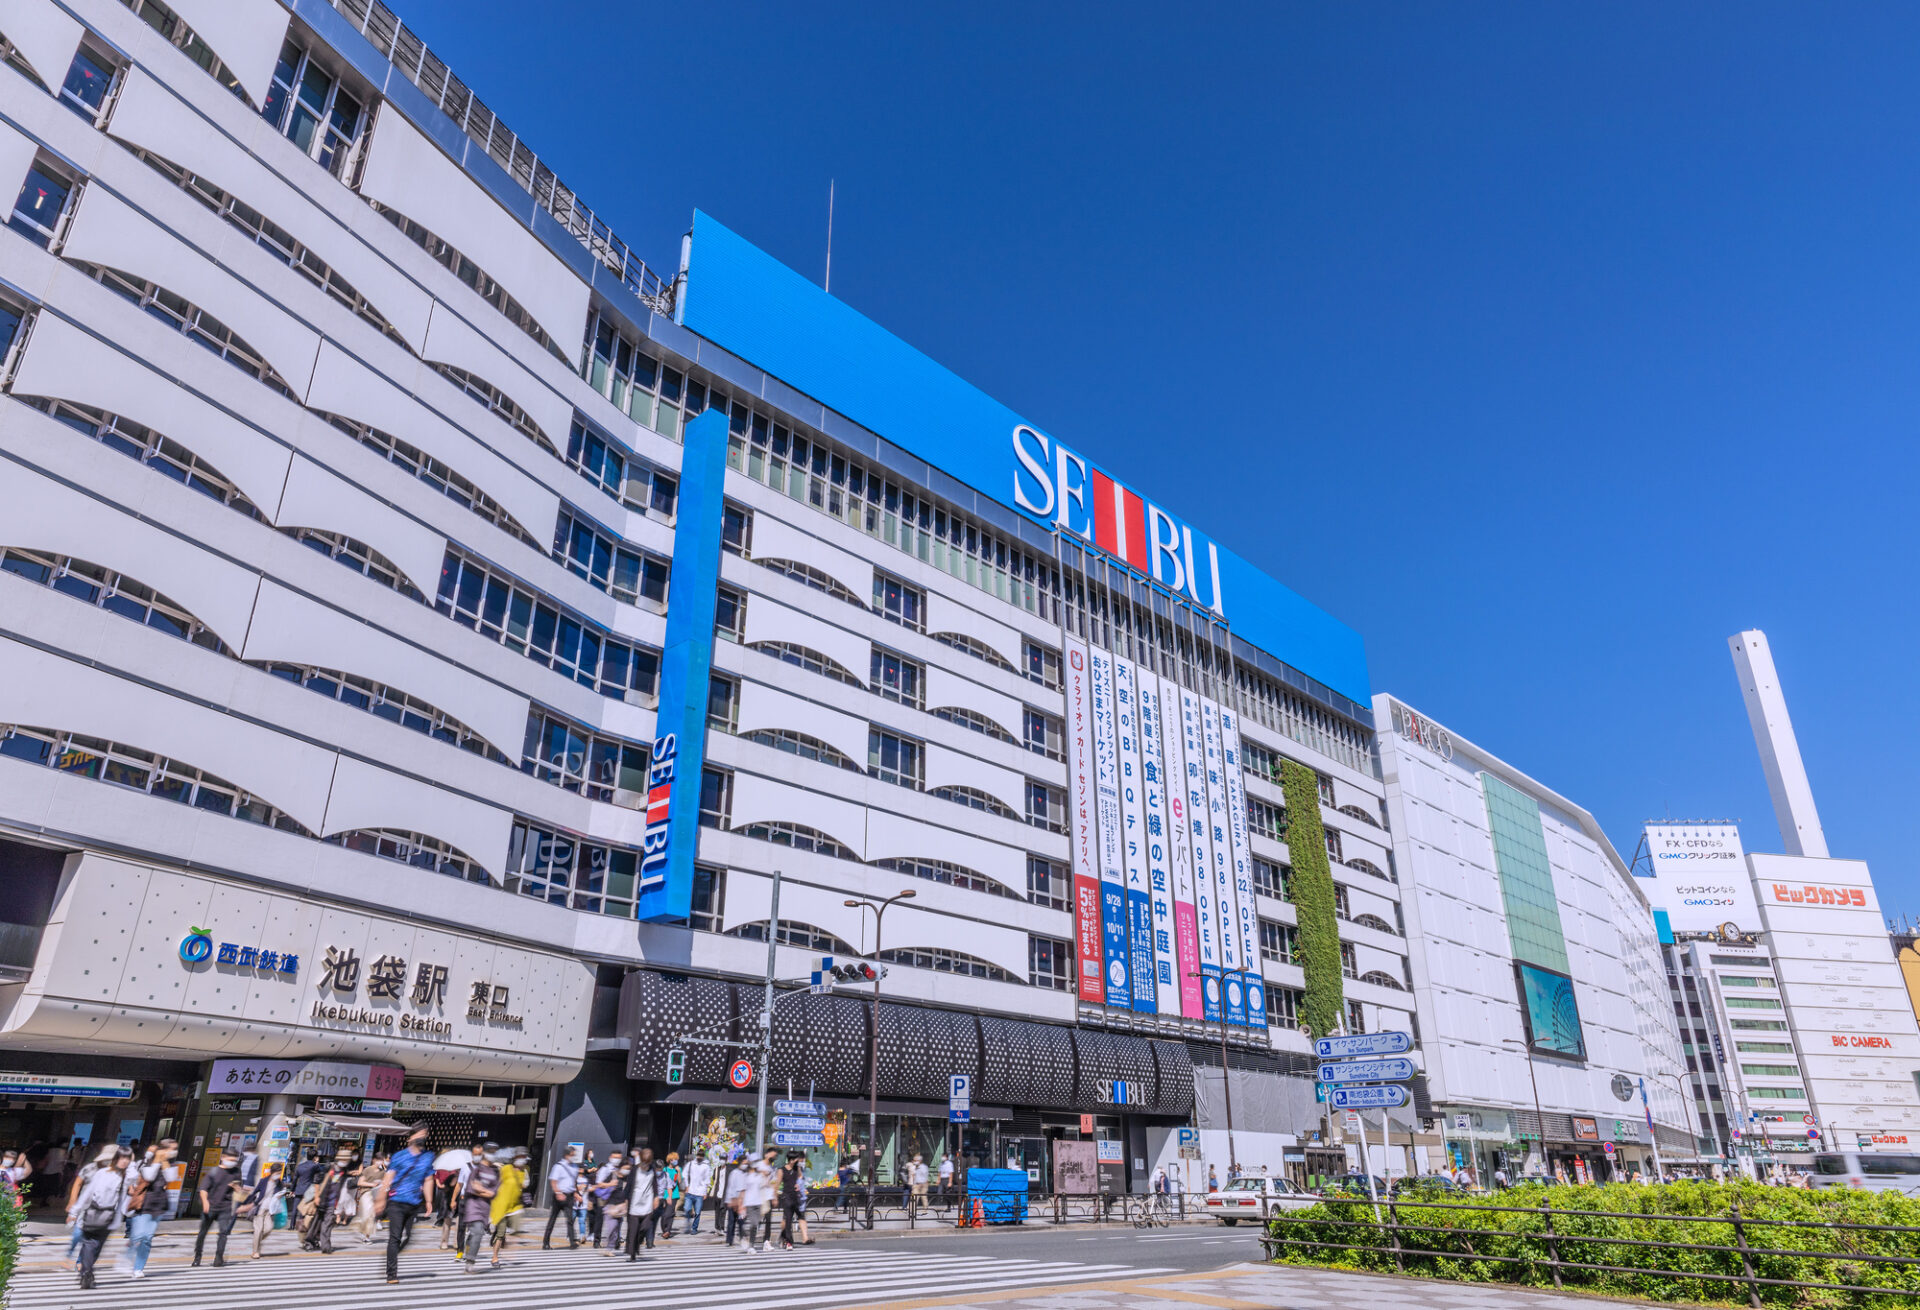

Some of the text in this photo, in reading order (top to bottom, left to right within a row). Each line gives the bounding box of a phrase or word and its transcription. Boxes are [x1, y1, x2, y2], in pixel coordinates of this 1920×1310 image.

[1012, 424, 1224, 622] SEIBU
[1093, 655, 1107, 780] おひさまマーケット
[1399, 706, 1453, 760] PARCO
[640, 733, 677, 890] SEIBU
[1230, 779, 1241, 847] SAKAGURA
[1241, 907, 1253, 969] OPEN
[1676, 886, 1736, 894] ビットコインなら
[1772, 883, 1866, 906] ビックカメラ
[1200, 896, 1212, 959] OPEN
[1221, 901, 1233, 964] OPEN
[217, 942, 299, 974] 西武鉄道
[317, 944, 449, 1006] 池袋駅
[471, 980, 510, 1008] 東口
[311, 1000, 452, 1035] Ikebukuro Station
[468, 1006, 524, 1024] East Entrance
[1832, 1035, 1892, 1048] BIC CAMERA
[1335, 1063, 1391, 1073] サンシャインシティ
[954, 1079, 965, 1096] P
[1096, 1079, 1146, 1105] SEIBU
[1349, 1089, 1384, 1098] 南池袋公園
[1179, 1129, 1193, 1146] P
[1872, 1135, 1908, 1144] ビックカメラ
